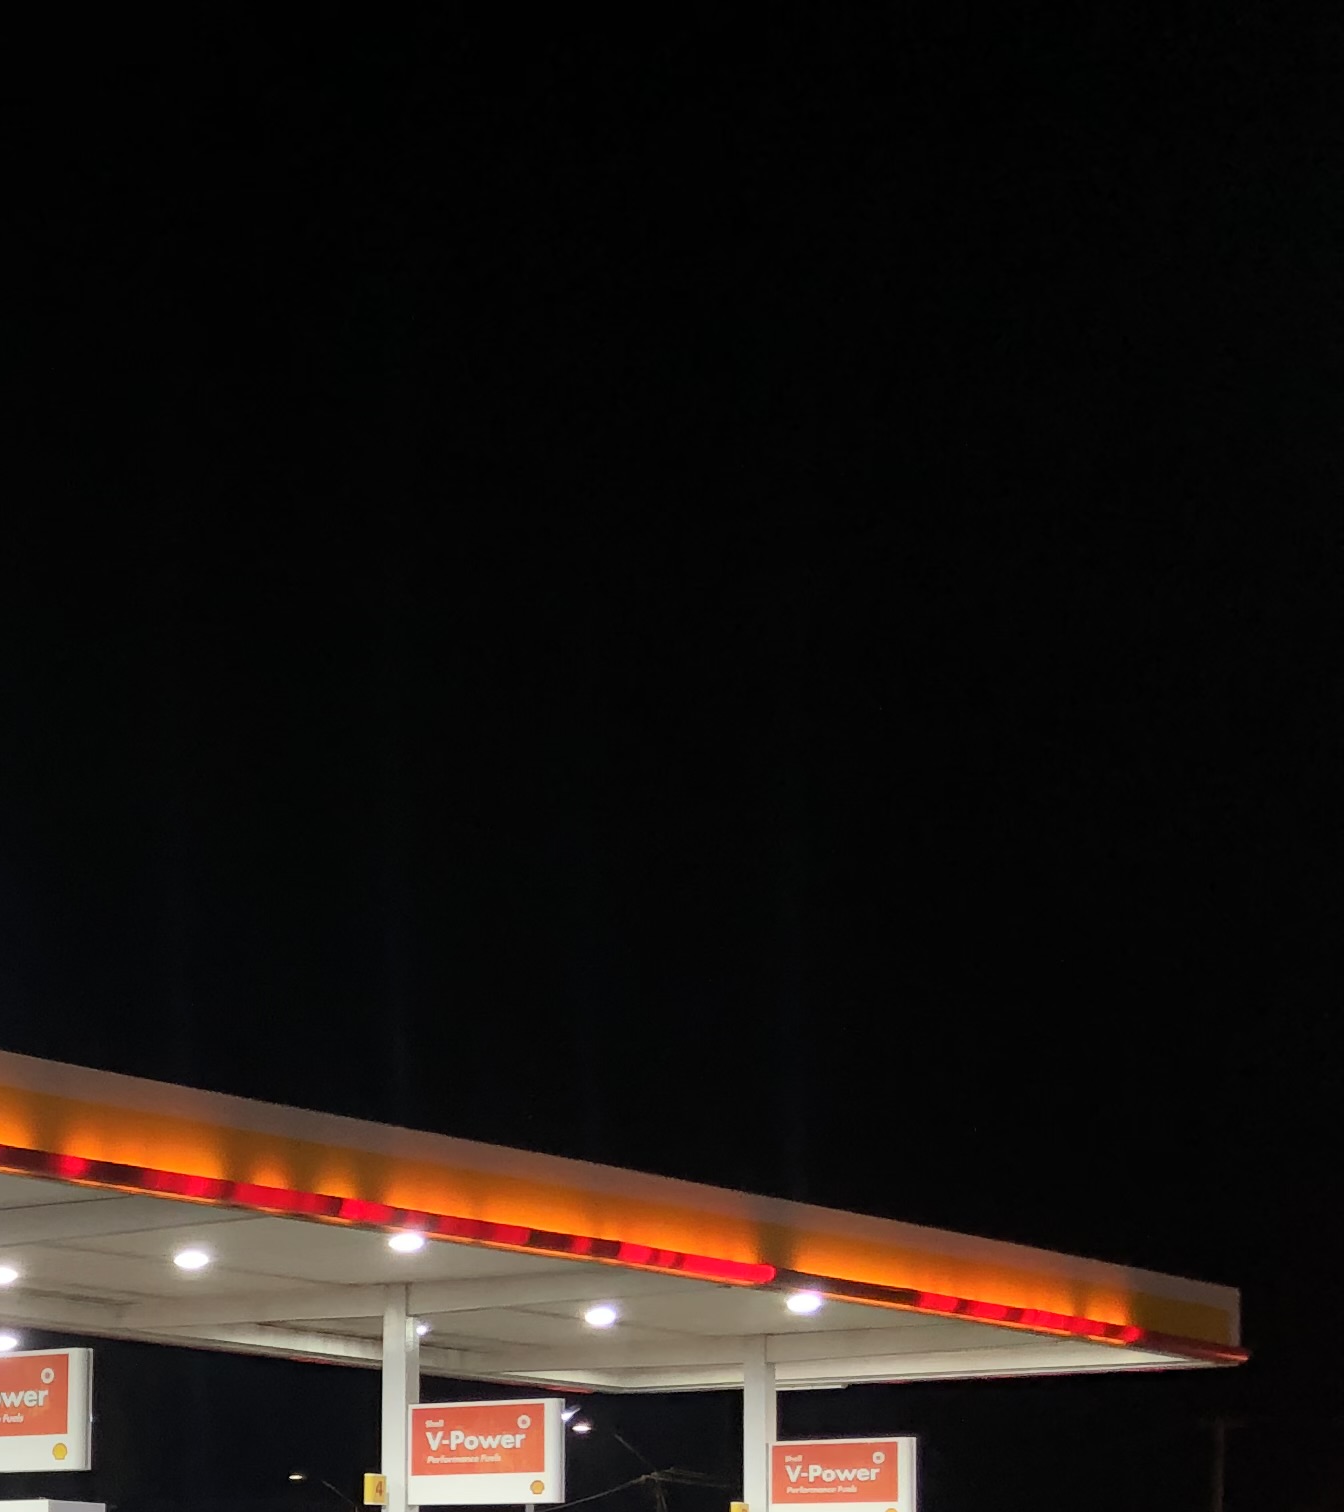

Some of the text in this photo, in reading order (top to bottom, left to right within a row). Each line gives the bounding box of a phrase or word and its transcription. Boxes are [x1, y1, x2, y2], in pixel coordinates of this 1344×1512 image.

[425, 1430, 526, 1451] V-Power
[784, 1465, 880, 1483] V-Power
[375, 1480, 384, 1496] 4
